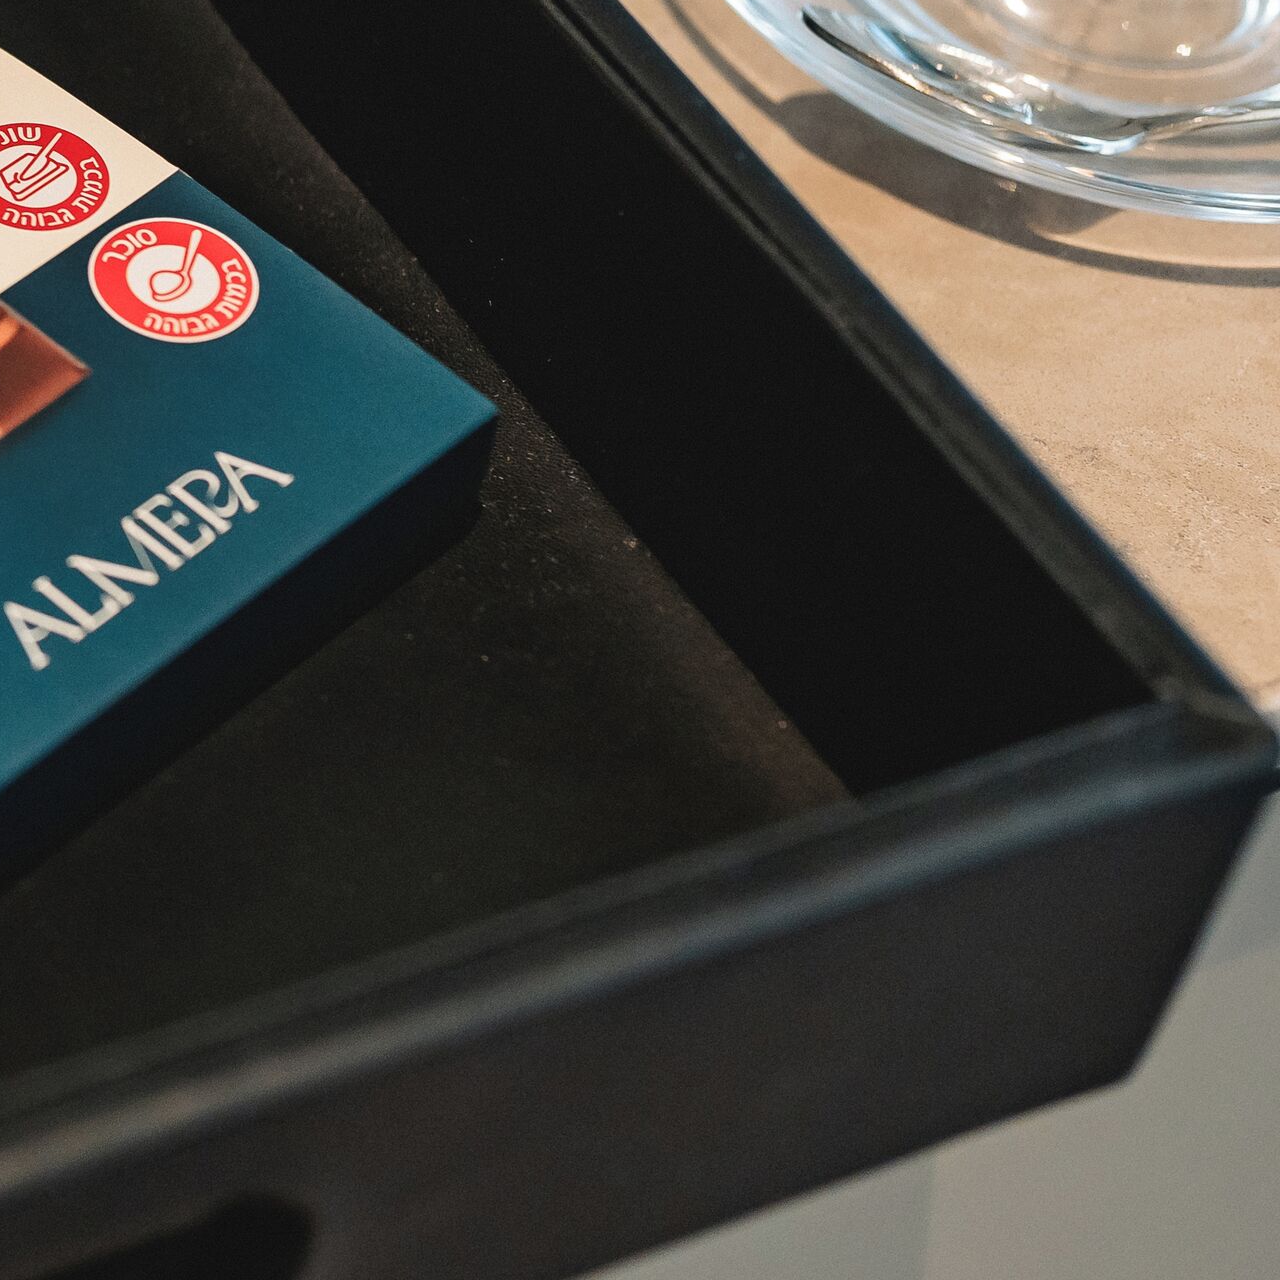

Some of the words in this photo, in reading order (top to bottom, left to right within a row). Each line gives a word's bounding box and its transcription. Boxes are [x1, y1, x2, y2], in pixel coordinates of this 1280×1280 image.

[71, 156, 104, 214] בכמות
[1, 207, 77, 227] גבוהה
[100, 227, 159, 264] סוכר
[214, 257, 248, 321] בכמות
[142, 312, 220, 335] גבוהה
